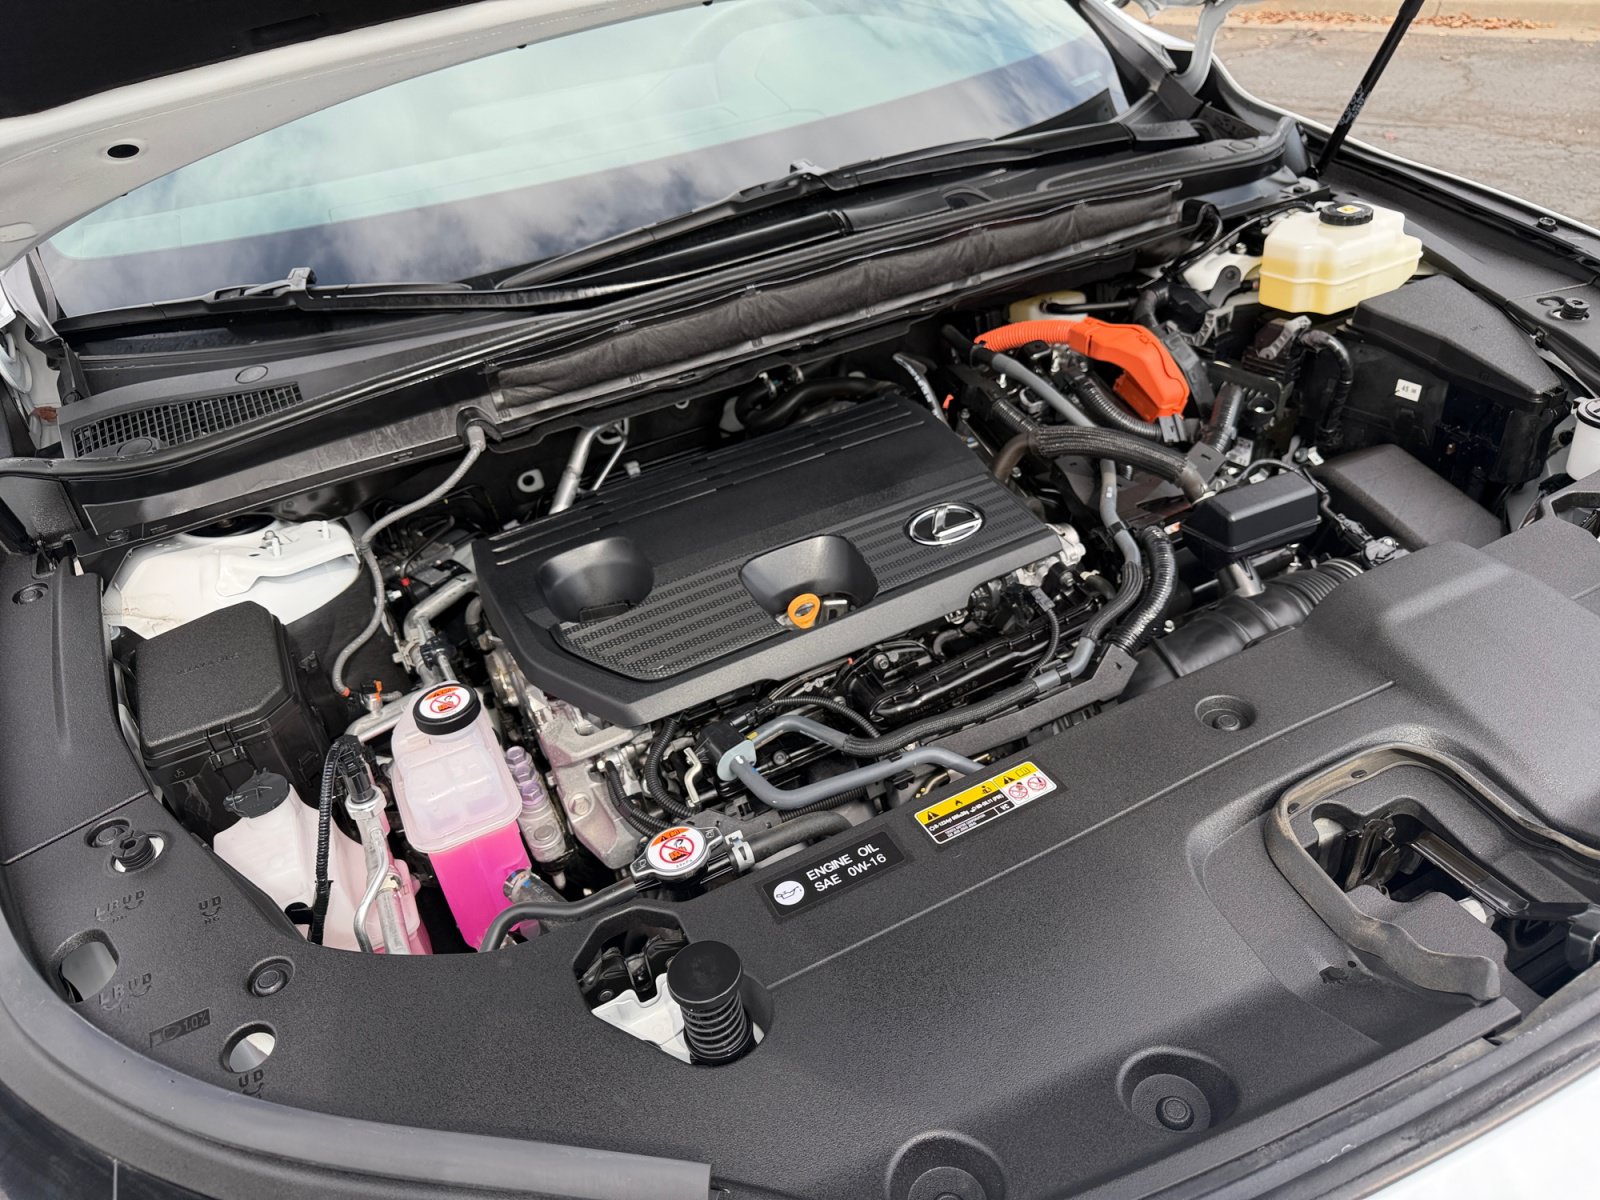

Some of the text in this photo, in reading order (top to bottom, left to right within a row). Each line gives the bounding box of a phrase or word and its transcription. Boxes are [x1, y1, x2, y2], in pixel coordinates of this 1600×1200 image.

[806, 843, 880, 881] ENGINE OIL
[814, 853, 887, 892] SAE 0W-16
